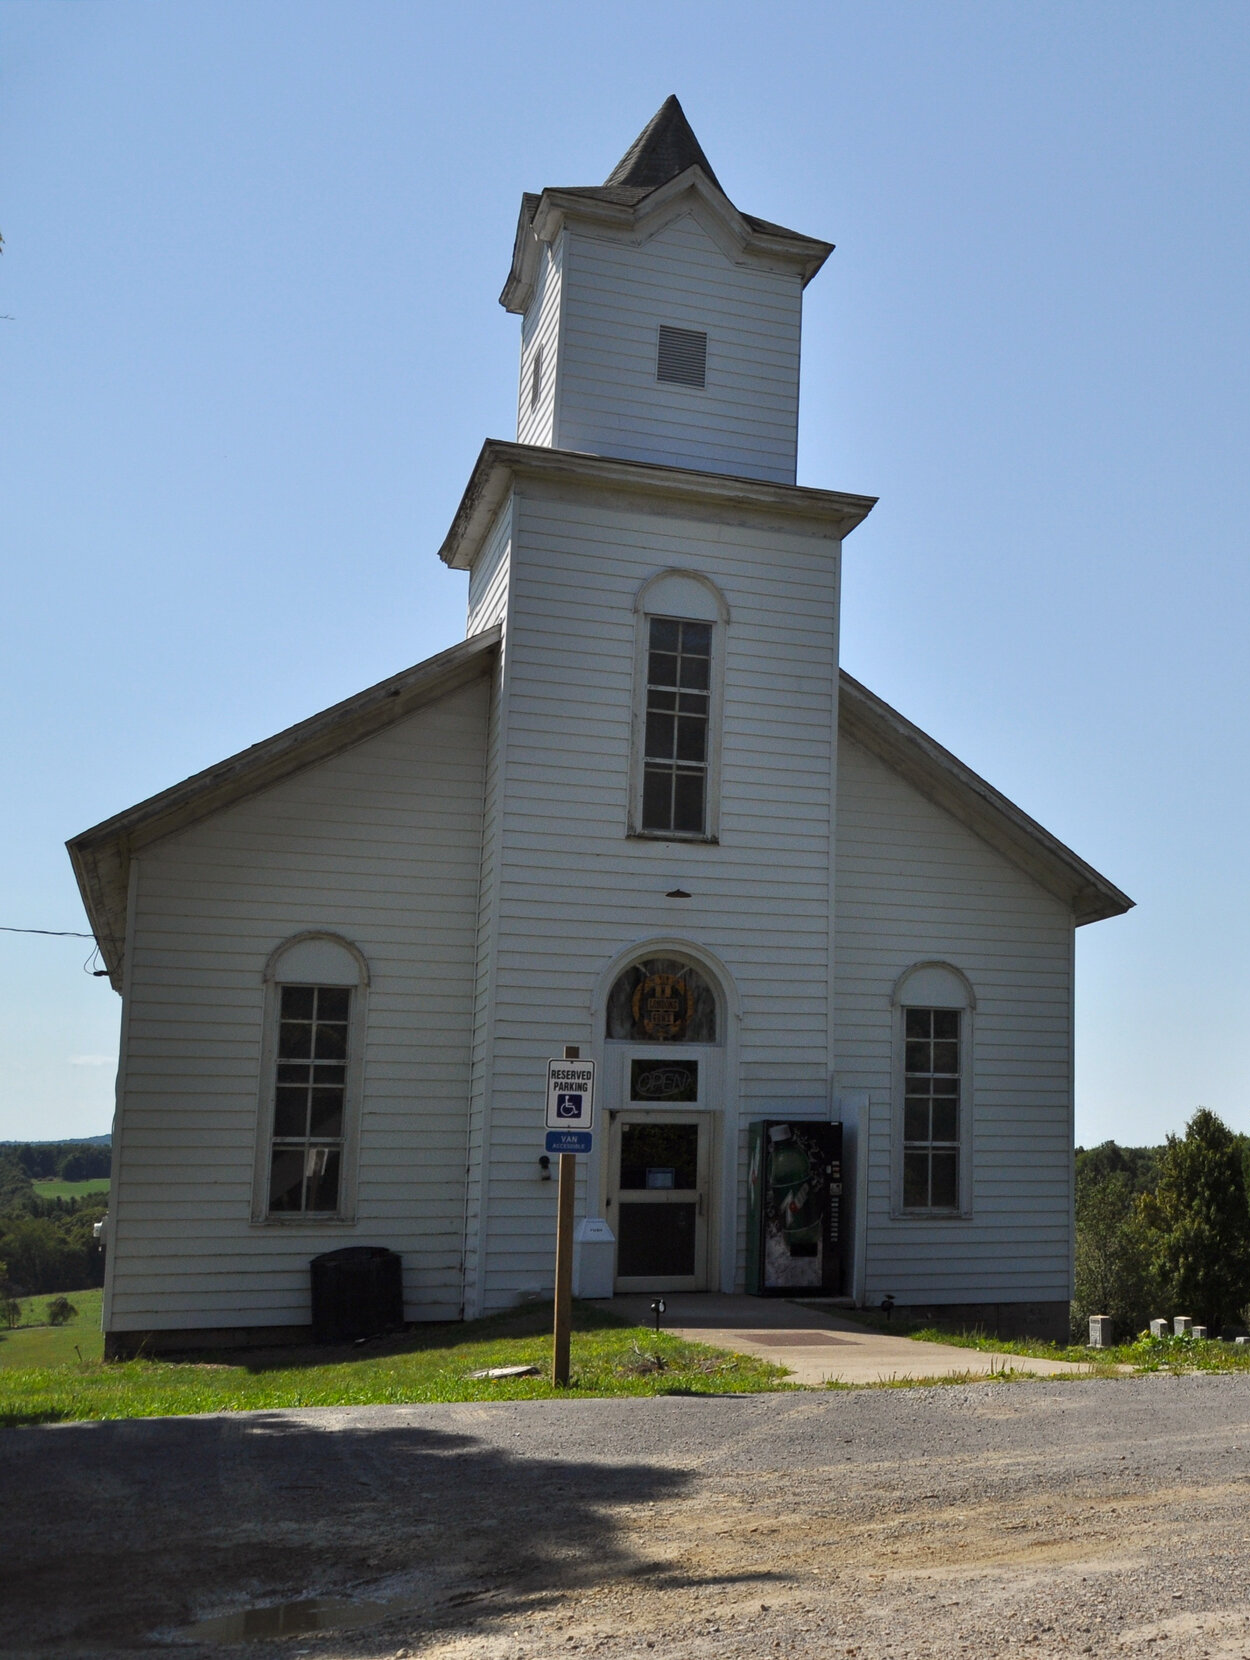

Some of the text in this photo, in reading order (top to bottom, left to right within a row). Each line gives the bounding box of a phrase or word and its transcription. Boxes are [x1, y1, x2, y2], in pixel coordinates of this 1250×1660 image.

[551, 1070, 592, 1080] RESERVED
[553, 1081, 588, 1092] PARKING
[638, 1072, 687, 1091] OPEN
